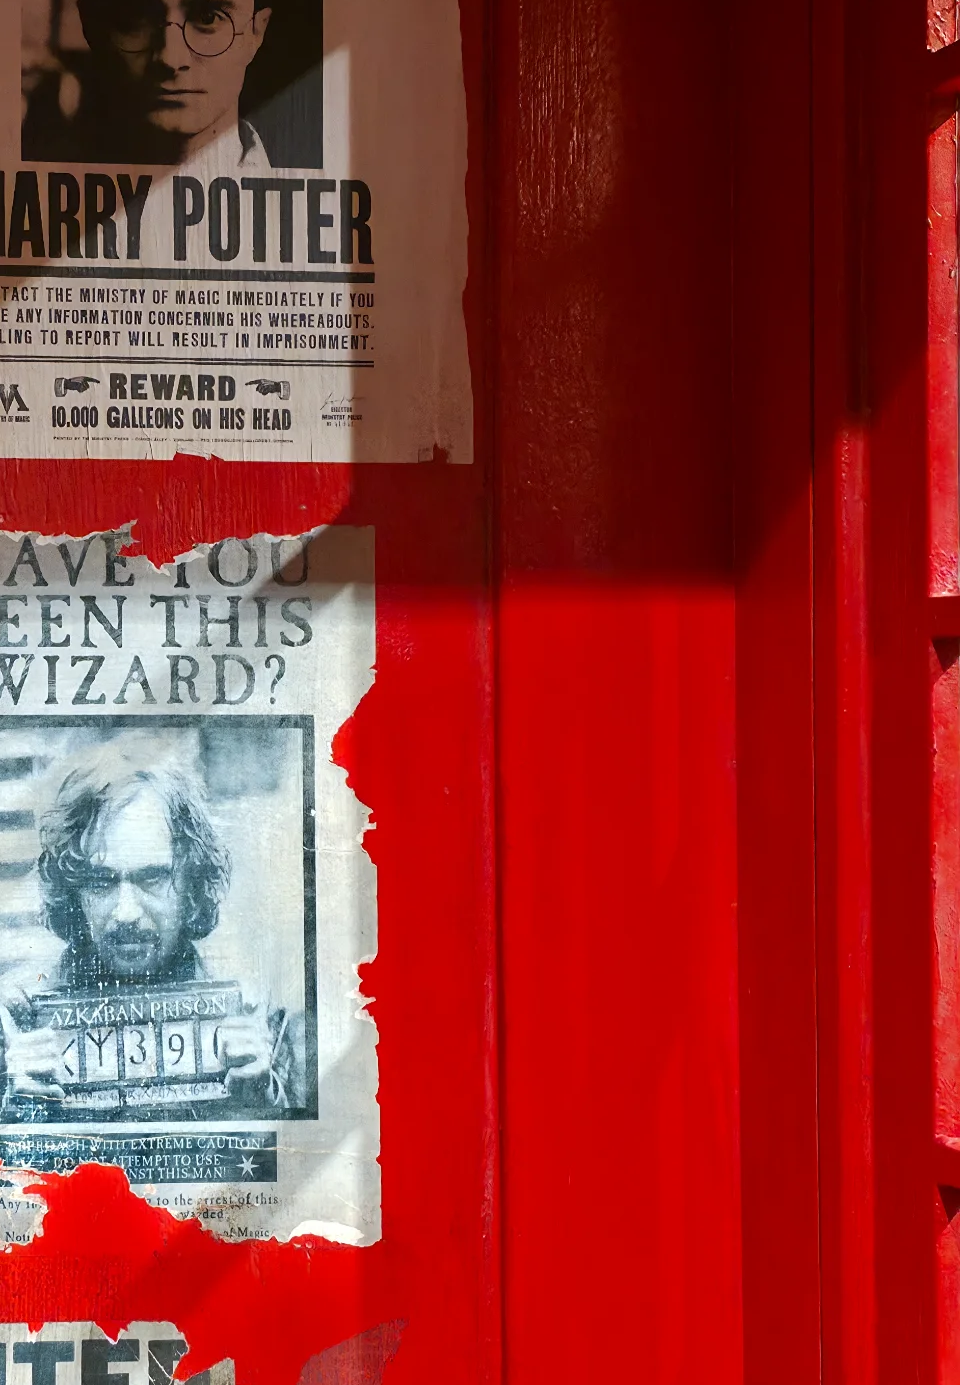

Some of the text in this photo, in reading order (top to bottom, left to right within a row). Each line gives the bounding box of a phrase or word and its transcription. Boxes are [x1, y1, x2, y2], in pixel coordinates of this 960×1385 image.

[172, 175, 375, 267] POTTER
[45, 287, 73, 303] THE
[79, 287, 146, 304] MINISTRY
[152, 289, 169, 305] OF
[175, 289, 220, 306] MAGIC
[226, 290, 325, 307] IMMEDIATELY
[330, 291, 343, 308] IF
[349, 291, 375, 308] YOU
[15, 307, 43, 324] ANY
[48, 308, 143, 325] INFORMATION
[148, 310, 234, 327] CONCERNING
[240, 311, 262, 328] HIS
[268, 312, 375, 330] WHEREABOUTS.
[40, 329, 59, 346] TO
[65, 329, 121, 347] REPORT
[128, 330, 165, 347] WILL
[172, 331, 229, 349] RESULT
[235, 332, 250, 349] IN
[257, 332, 375, 351] IMPRISONMENT.
[109, 372, 236, 402] REWARD
[106, 405, 184, 430] GALLEONS
[192, 407, 212, 430] ON
[219, 407, 245, 431] HIS
[252, 407, 292, 431] HEAD
[149, 593, 315, 648] THIS
[49, 994, 227, 1027] AZKABAN PRISON
[130, 1137, 193, 1150] EXTREME
[196, 1136, 266, 1150] CAUTION!
[53, 1156, 73, 1169] DO
[111, 1154, 169, 1168] ATTEMPT
[173, 1154, 191, 1167] TO
[195, 1154, 221, 1167] USE
[157, 1167, 188, 1180] THIS
[156, 1197, 169, 1206] to
[173, 1194, 193, 1206] the
[237, 1192, 251, 1206] of
[255, 1192, 279, 1205] this
